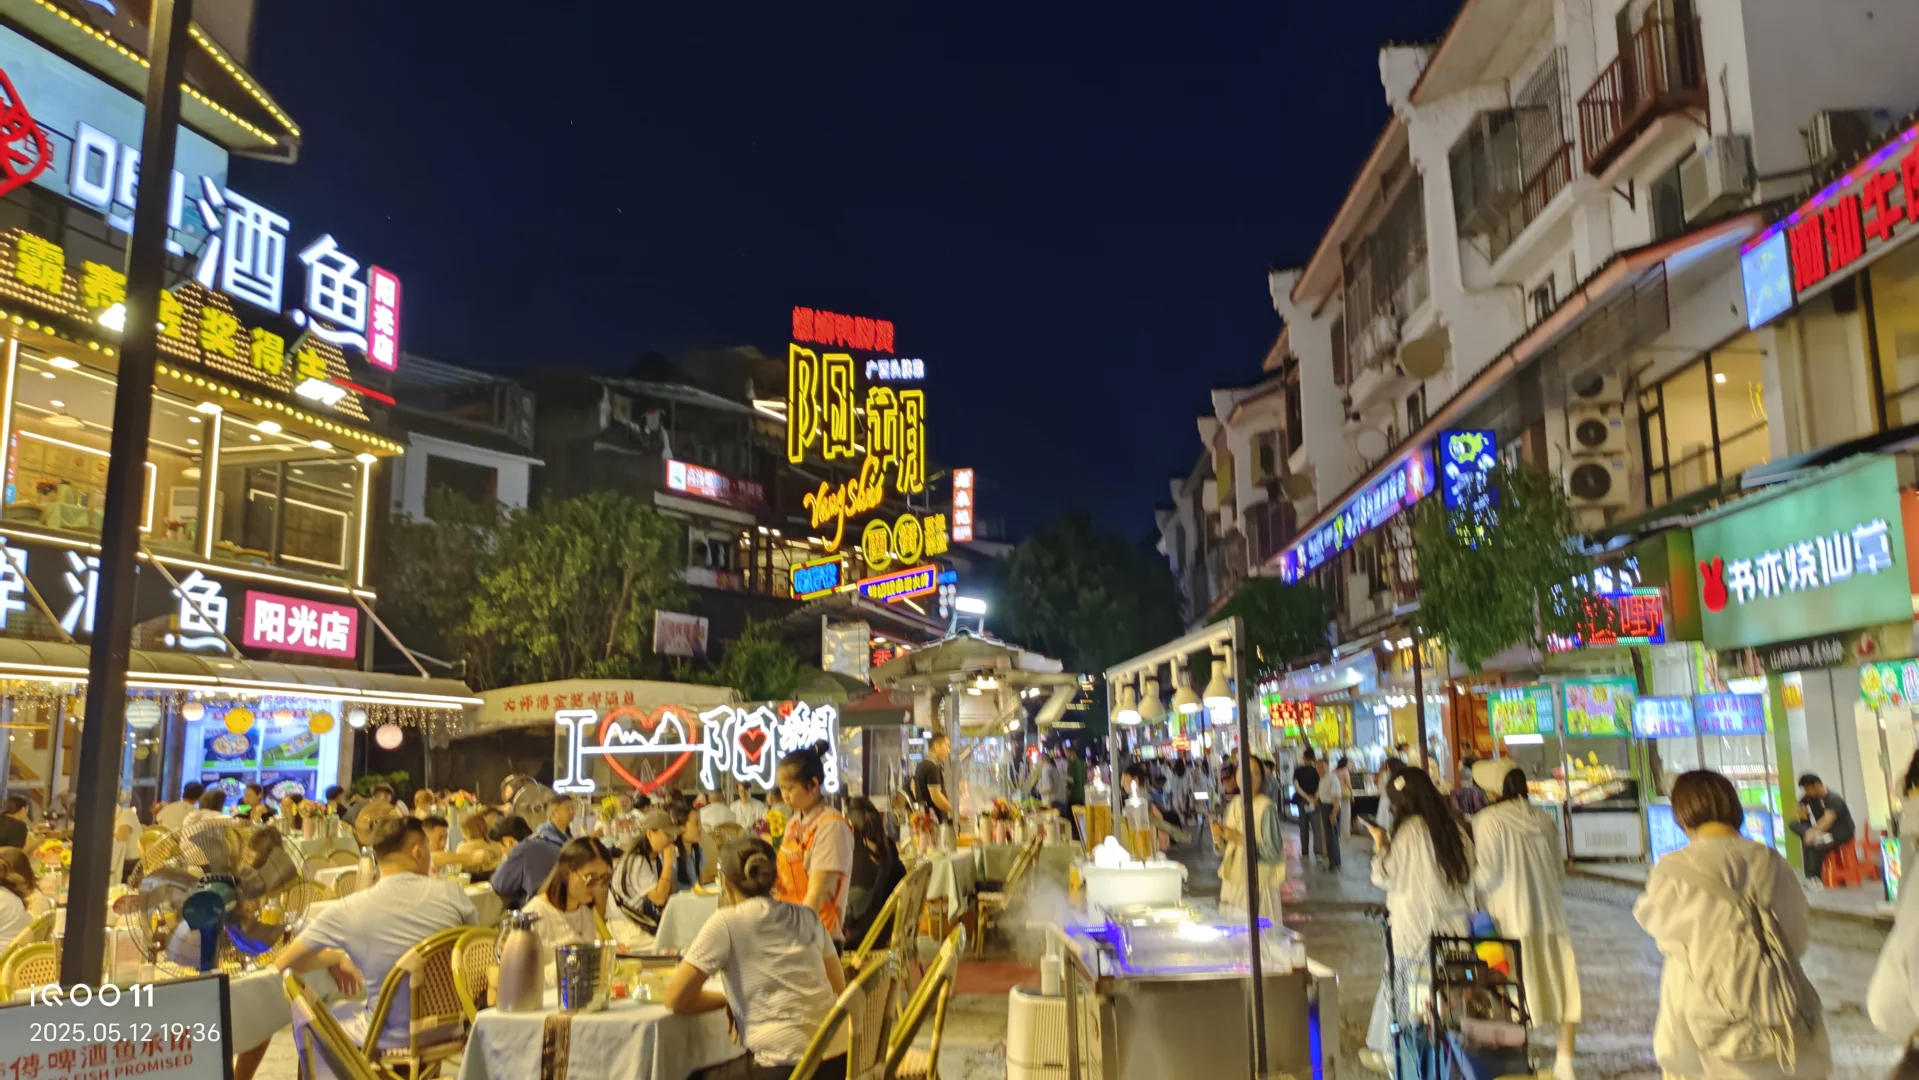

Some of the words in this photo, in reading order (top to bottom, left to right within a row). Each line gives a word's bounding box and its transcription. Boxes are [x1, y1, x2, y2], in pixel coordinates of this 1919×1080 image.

[371, 269, 399, 368] 阳光店
[788, 342, 926, 494] 阳朔
[1728, 517, 1893, 606] 书亦烧仙草
[253, 600, 350, 652] 阳光店
[553, 708, 597, 793] I
[0, 1028, 192, 1080] 傅啤酒鱼承诺
[114, 1053, 193, 1079] PROMISED
